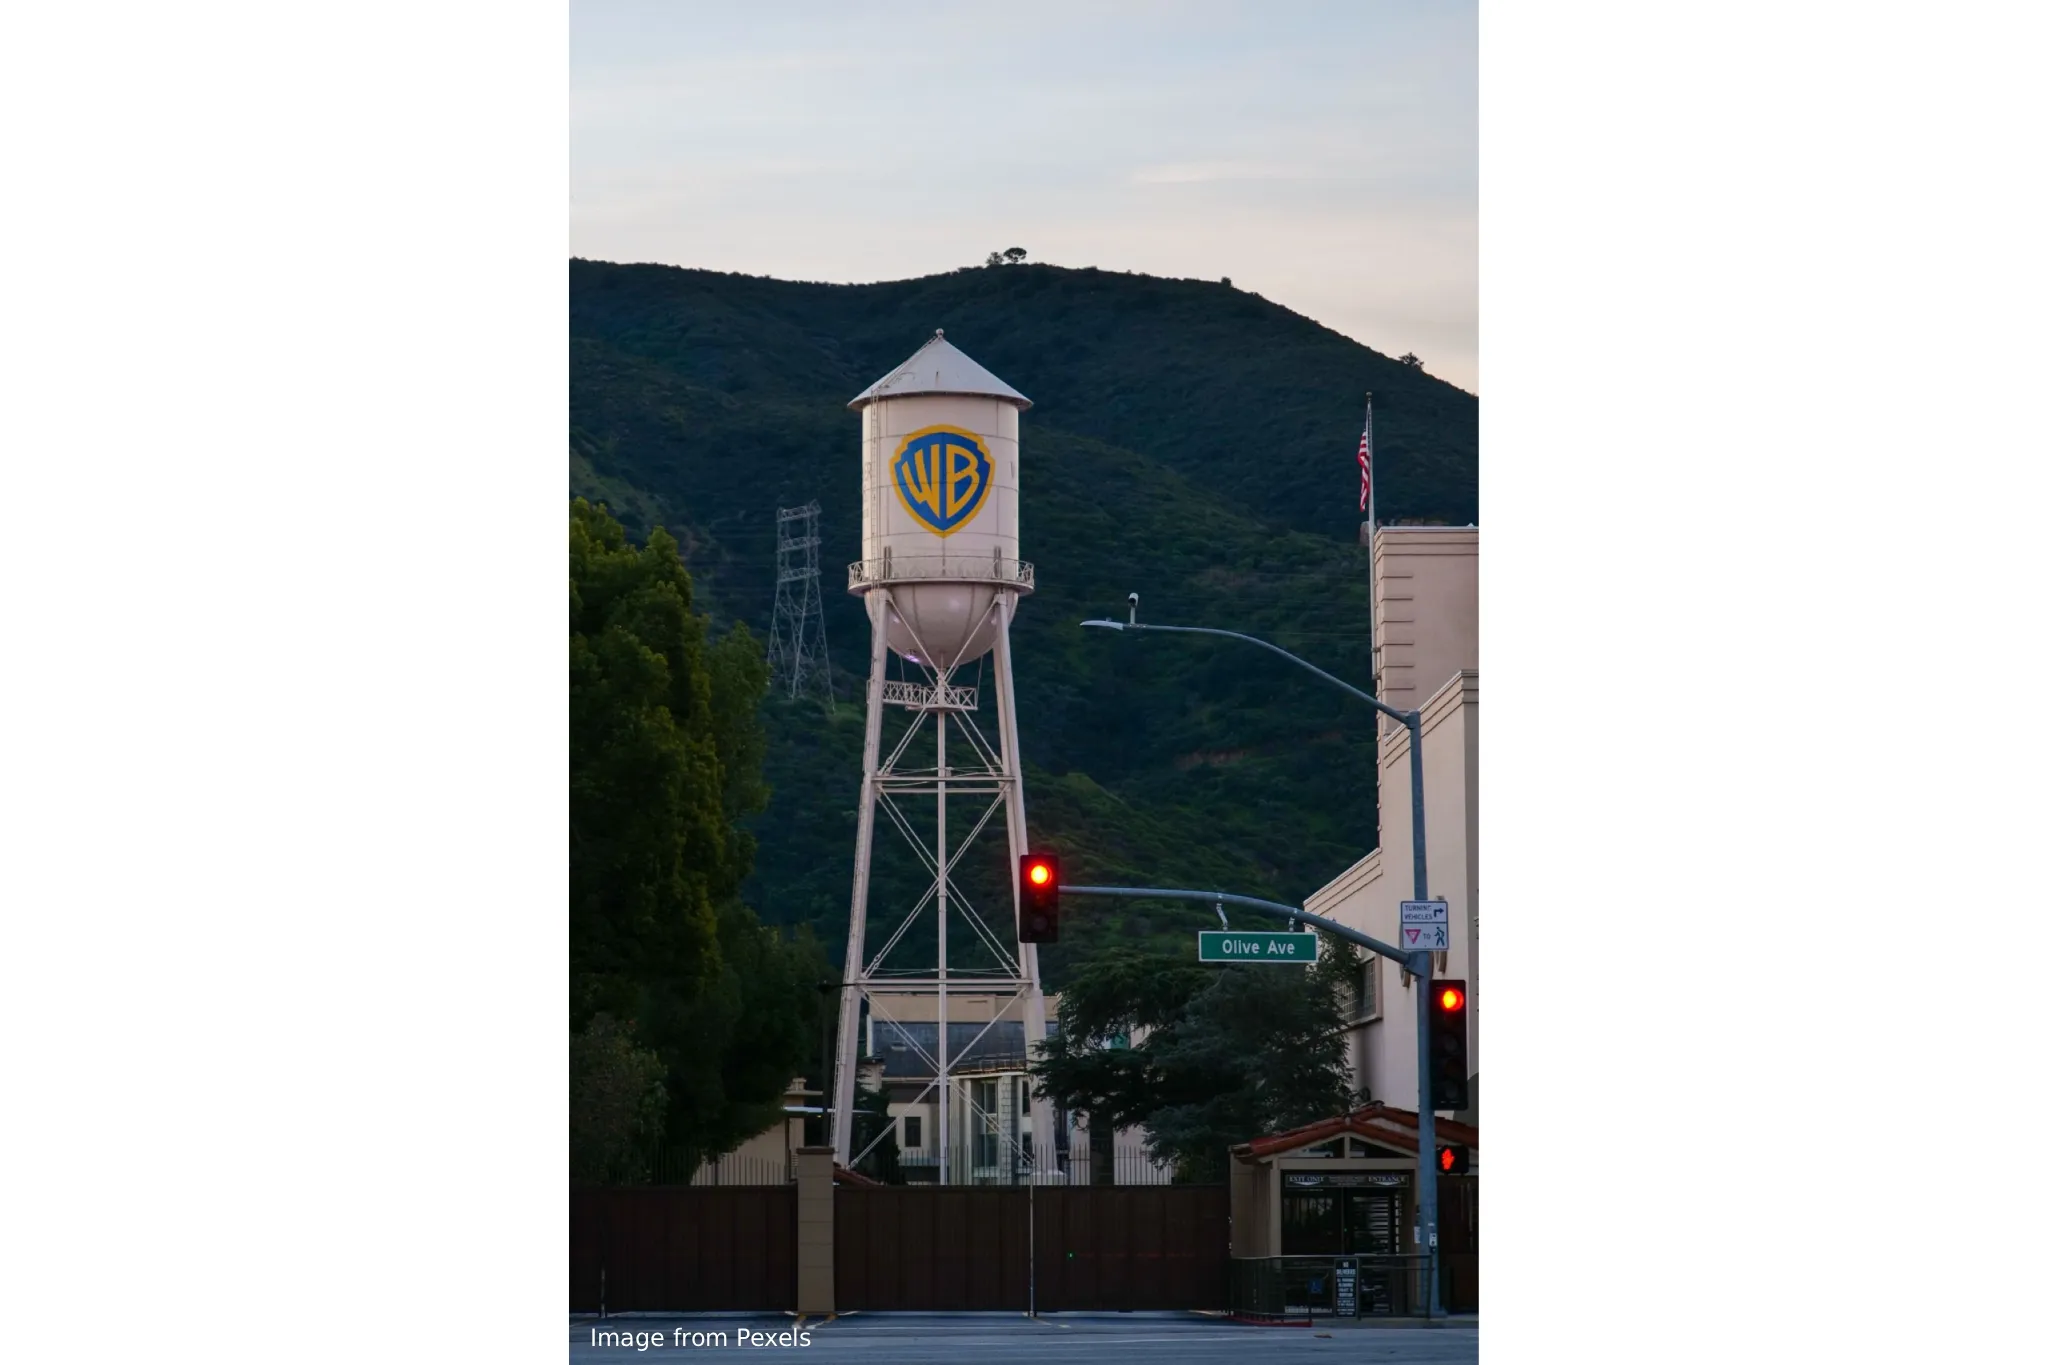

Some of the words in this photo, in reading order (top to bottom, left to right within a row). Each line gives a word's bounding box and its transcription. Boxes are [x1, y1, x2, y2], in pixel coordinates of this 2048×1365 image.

[902, 443, 980, 519] WB
[1222, 940, 1260, 954] Olive
[1267, 940, 1296, 955] Ave
